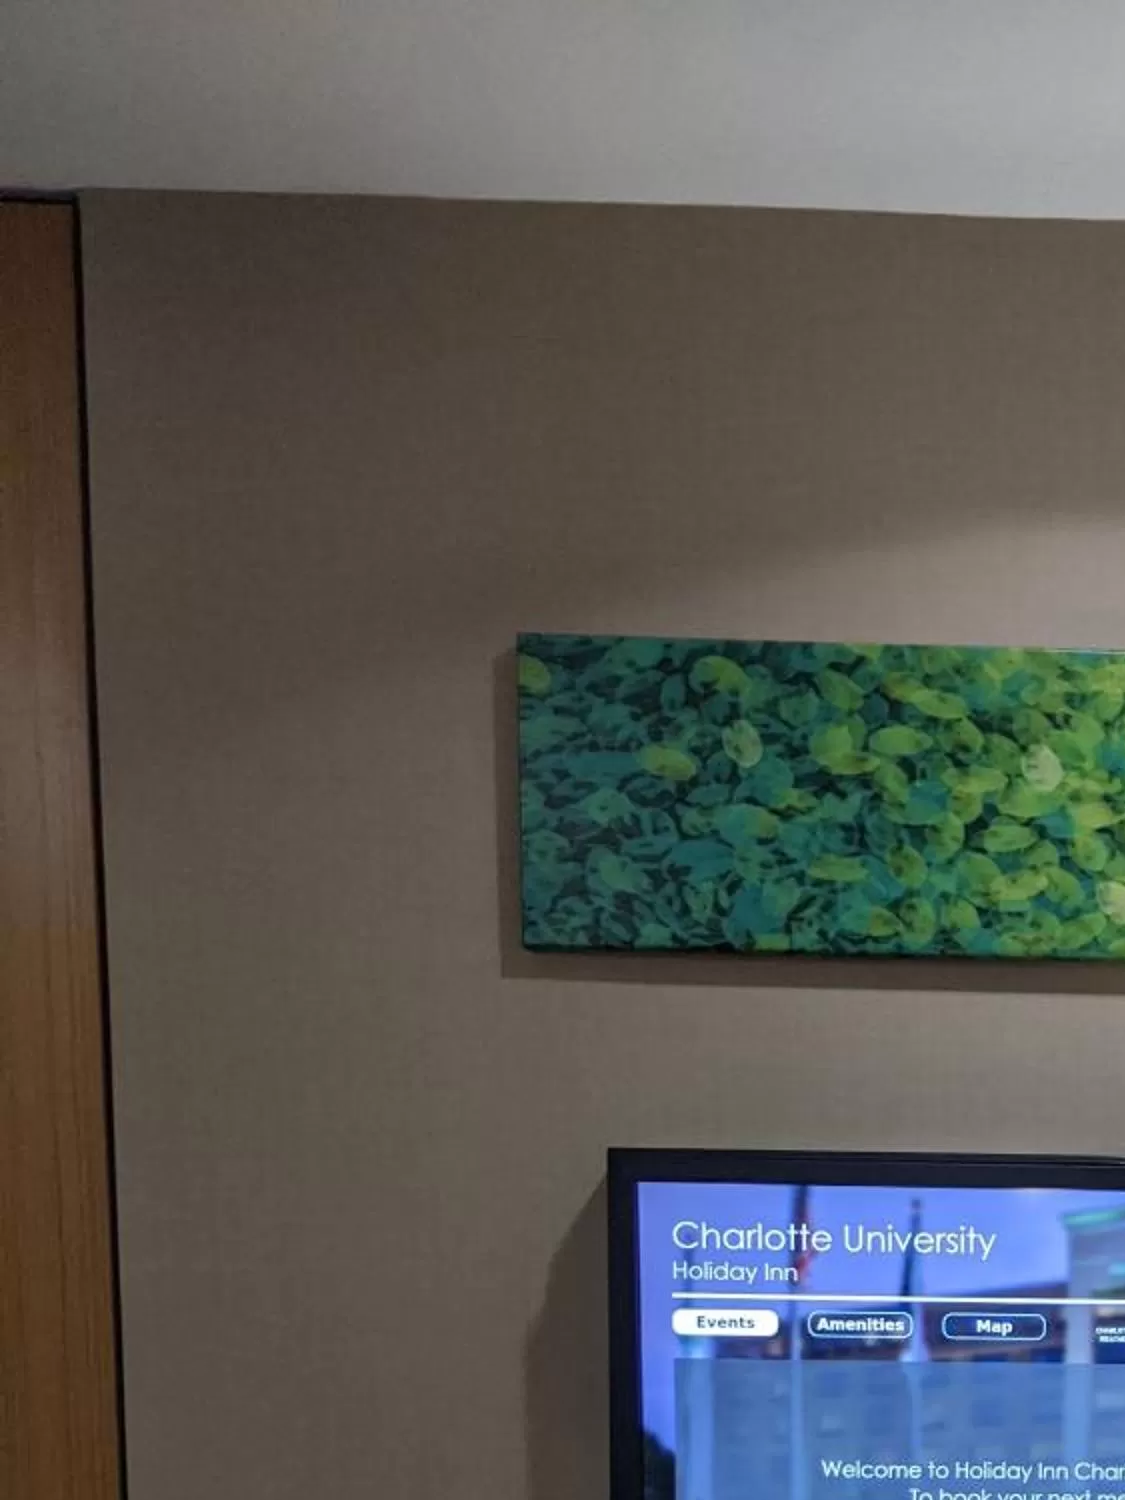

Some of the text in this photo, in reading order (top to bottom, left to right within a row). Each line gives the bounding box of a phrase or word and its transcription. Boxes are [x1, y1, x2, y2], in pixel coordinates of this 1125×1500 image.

[672, 1221, 997, 1261] Charlotte University
[672, 1261, 798, 1285] Holiday Inn
[696, 1315, 755, 1330] Events
[817, 1316, 905, 1333] Amenities
[976, 1319, 1013, 1337] Map
[821, 1459, 922, 1480] Welcome
[927, 1461, 949, 1479] to
[955, 1461, 1033, 1484] Holiday
[1038, 1463, 1069, 1480] Inn
